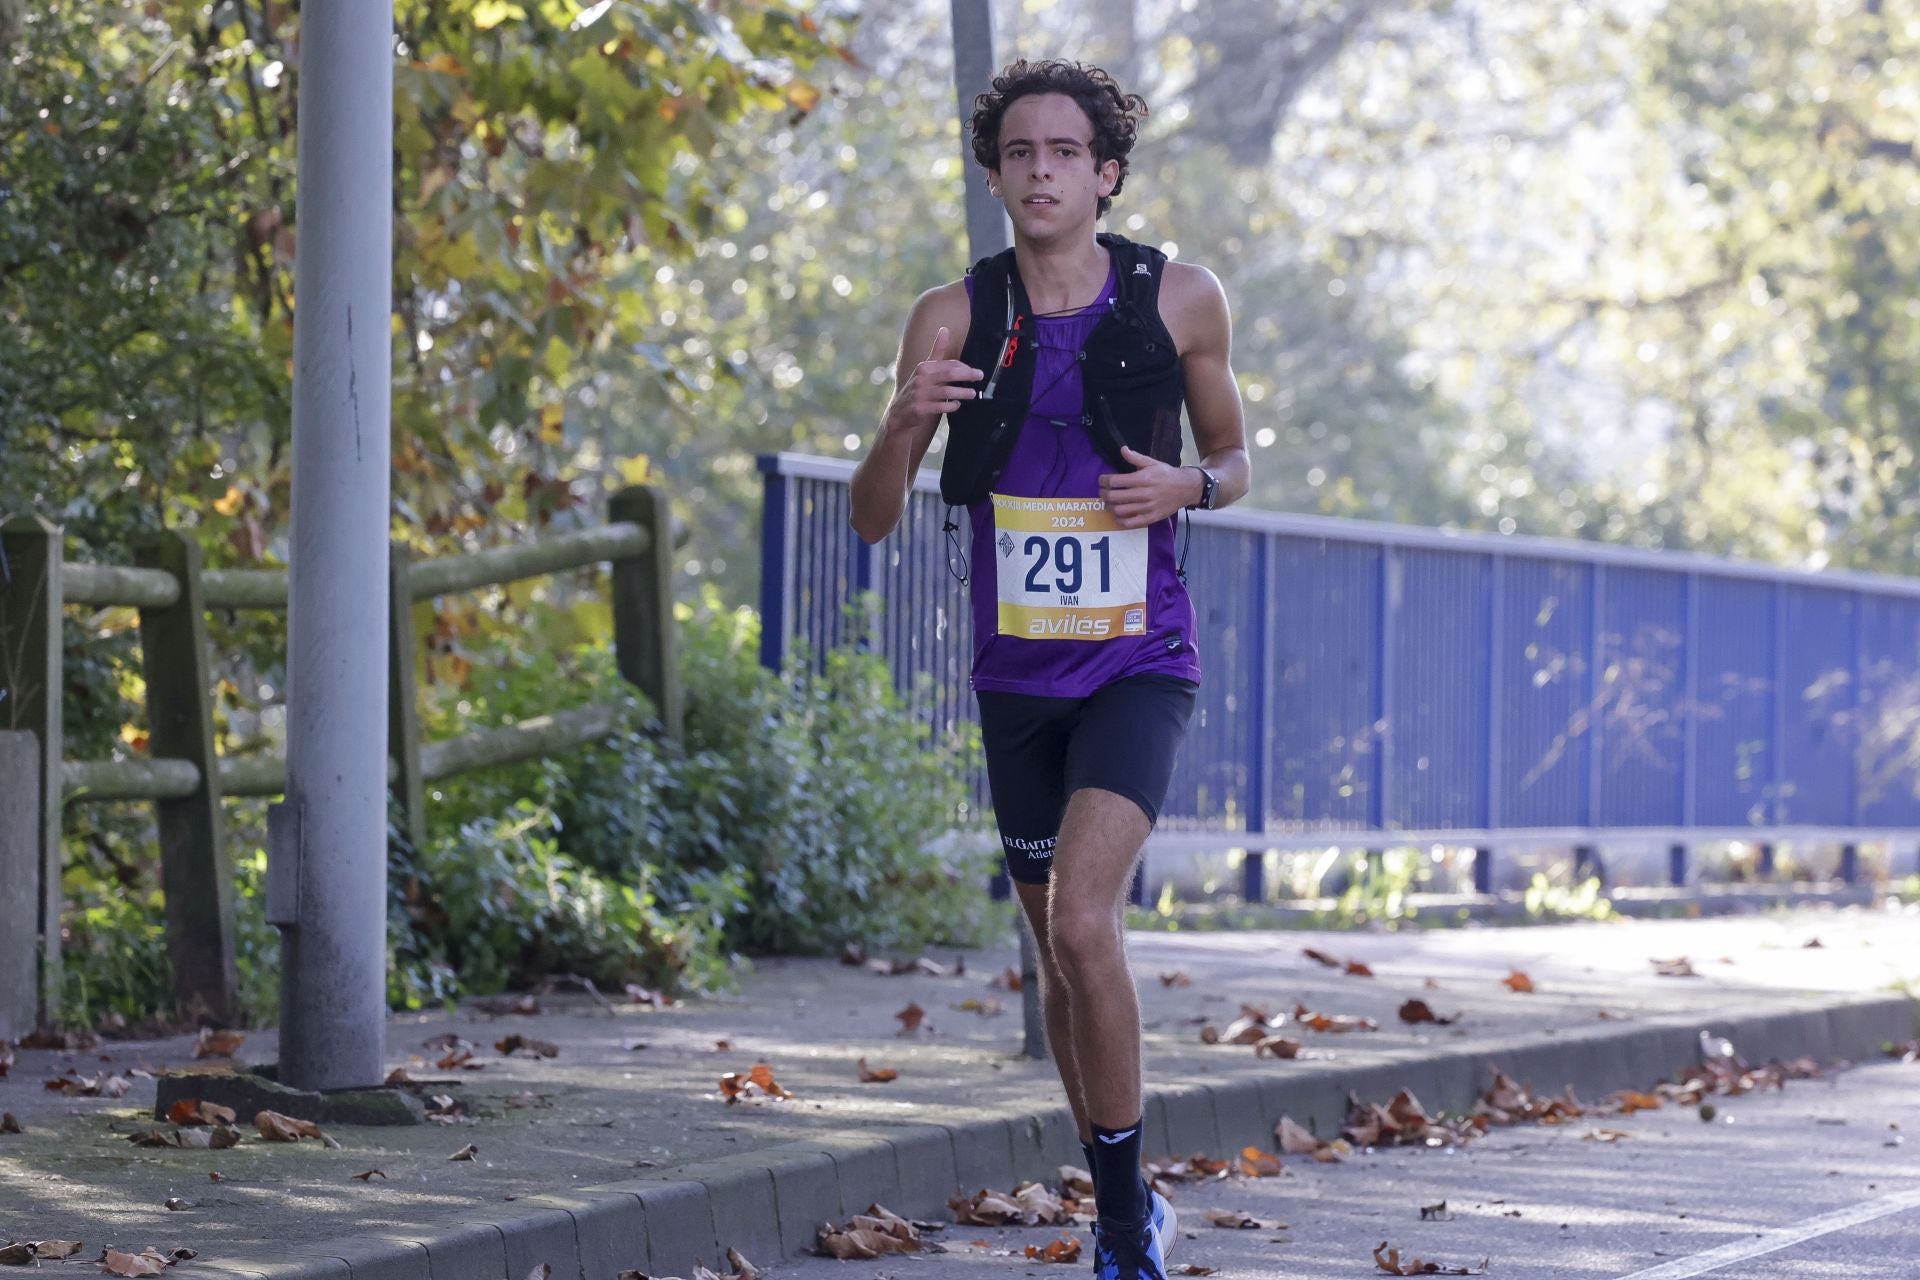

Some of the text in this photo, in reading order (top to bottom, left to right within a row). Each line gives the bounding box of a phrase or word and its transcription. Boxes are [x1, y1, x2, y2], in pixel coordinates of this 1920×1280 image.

[1023, 501, 1054, 511] MEDIA
[1051, 517, 1085, 528] 2024
[1023, 536, 1110, 594] 291
[1060, 595, 1079, 606] IVAN
[1028, 613, 1112, 635] avilés
[1015, 836, 1058, 850] GAITE
